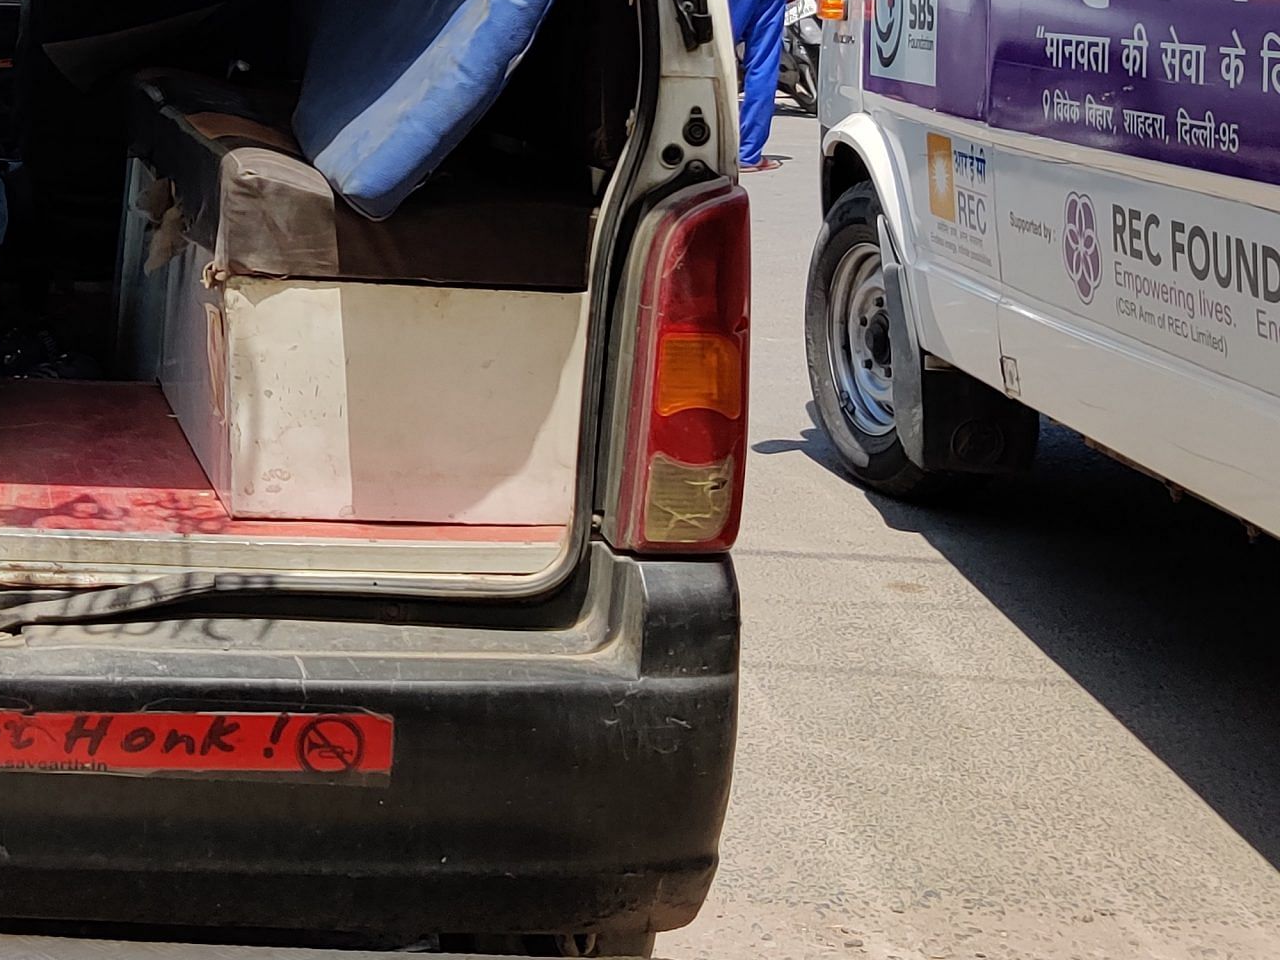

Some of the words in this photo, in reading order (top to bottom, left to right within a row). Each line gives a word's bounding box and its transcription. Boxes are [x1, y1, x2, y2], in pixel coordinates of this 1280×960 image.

[1121, 23, 1149, 79] की
[1160, 25, 1207, 86] सेवा
[1219, 29, 1246, 89] के
[1054, 89, 1080, 124] विवेक
[958, 190, 987, 235] REC
[1009, 210, 1042, 237] Supported
[1112, 203, 1162, 267] REC
[1171, 220, 1280, 304] FOUND
[1114, 261, 1195, 320] Empowering
[1199, 289, 1237, 329] lives.
[1256, 308, 1280, 344] En
[1116, 296, 1137, 320] (CSR
[1138, 305, 1157, 328] Arm
[1168, 316, 1189, 339] REC
[1190, 324, 1228, 359] Limited)
[63, 714, 241, 757] Honk
